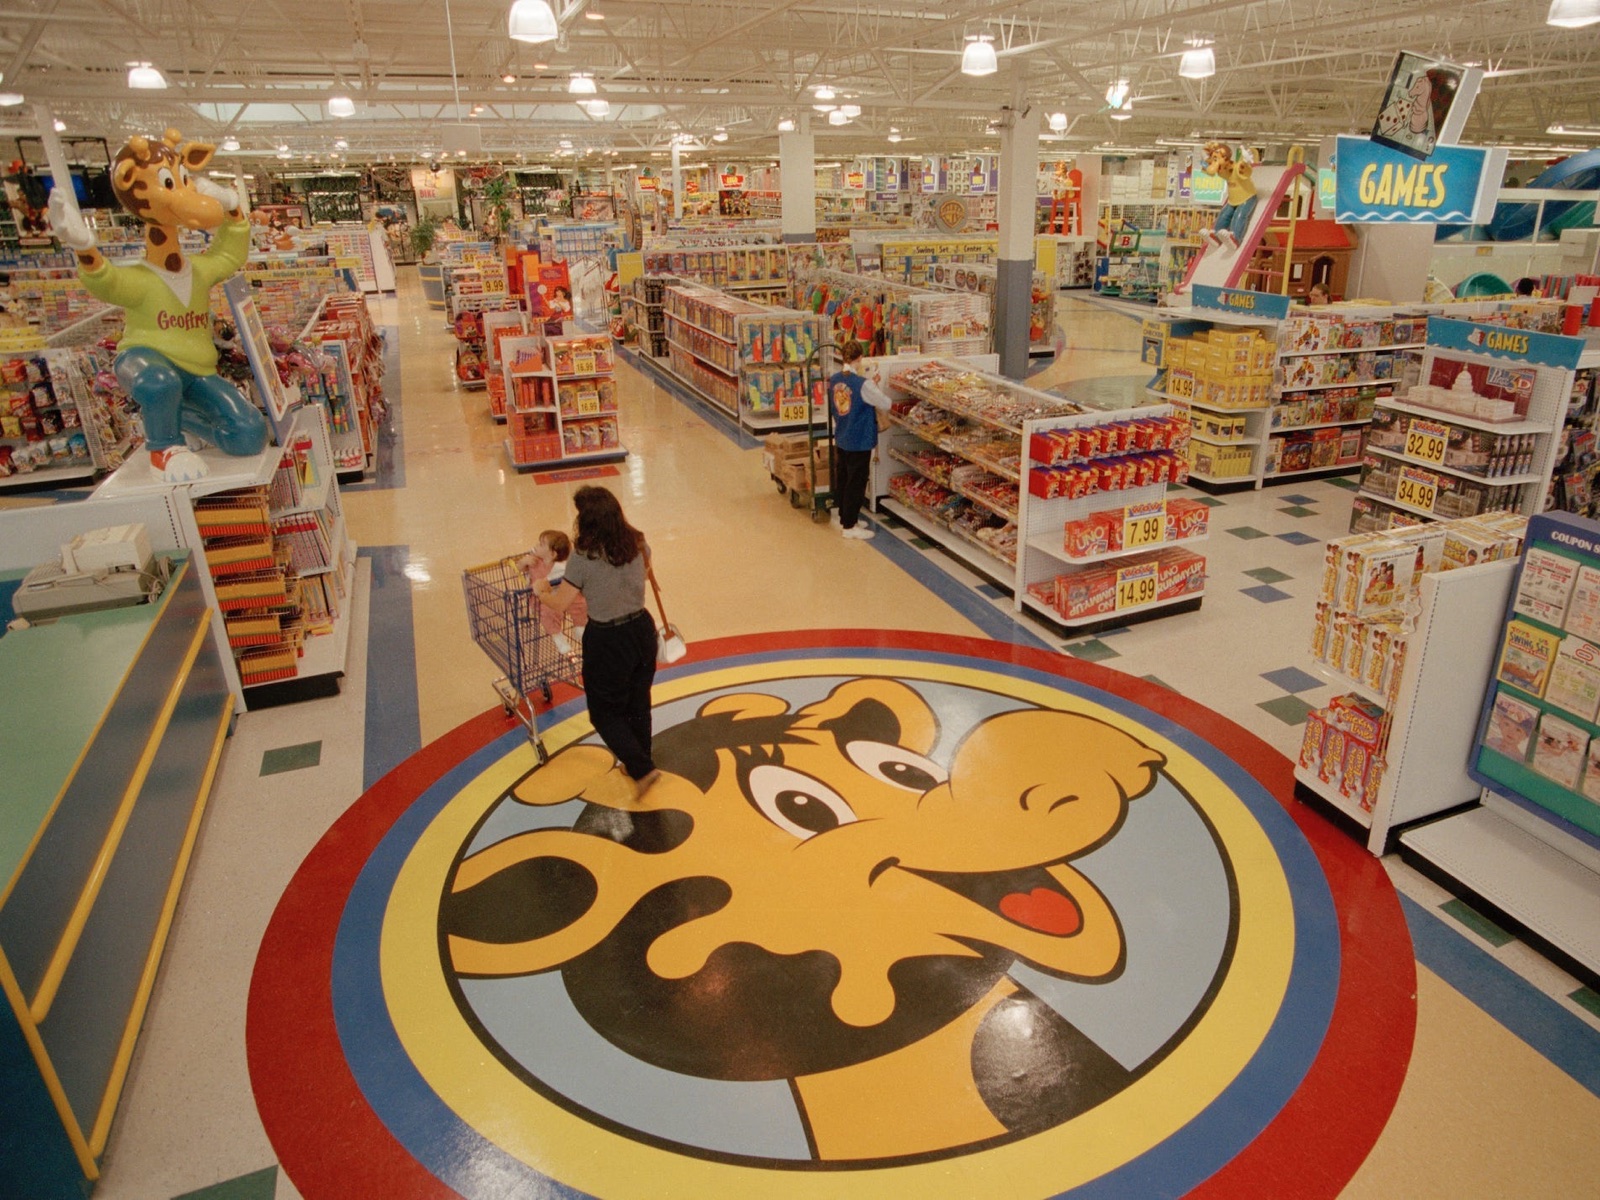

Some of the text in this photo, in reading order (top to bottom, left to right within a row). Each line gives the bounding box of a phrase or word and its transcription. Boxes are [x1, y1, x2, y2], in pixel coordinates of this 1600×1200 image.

[420, 189, 435, 198] BIKE
[1359, 163, 1449, 208] GAMES
[916, 246, 935, 254] Swing
[485, 280, 504, 292] 9.99
[1228, 293, 1255, 309] GAMES
[1486, 331, 1529, 354] GAMES
[1171, 379, 1193, 398] 14.99
[581, 402, 597, 412] 16.99
[784, 406, 805, 420] 4.99
[1407, 434, 1444, 461] 32.99
[1398, 480, 1434, 508] 34.99
[1130, 517, 1159, 545] 7.99
[1180, 509, 1205, 532] UNO
[1075, 526, 1105, 550] UNO
[1551, 530, 1592, 552] COUPON
[1160, 565, 1179, 582] UNO
[1119, 578, 1155, 606] 14.99
[1509, 631, 1534, 649] SWING
[1535, 641, 1550, 654] SET
